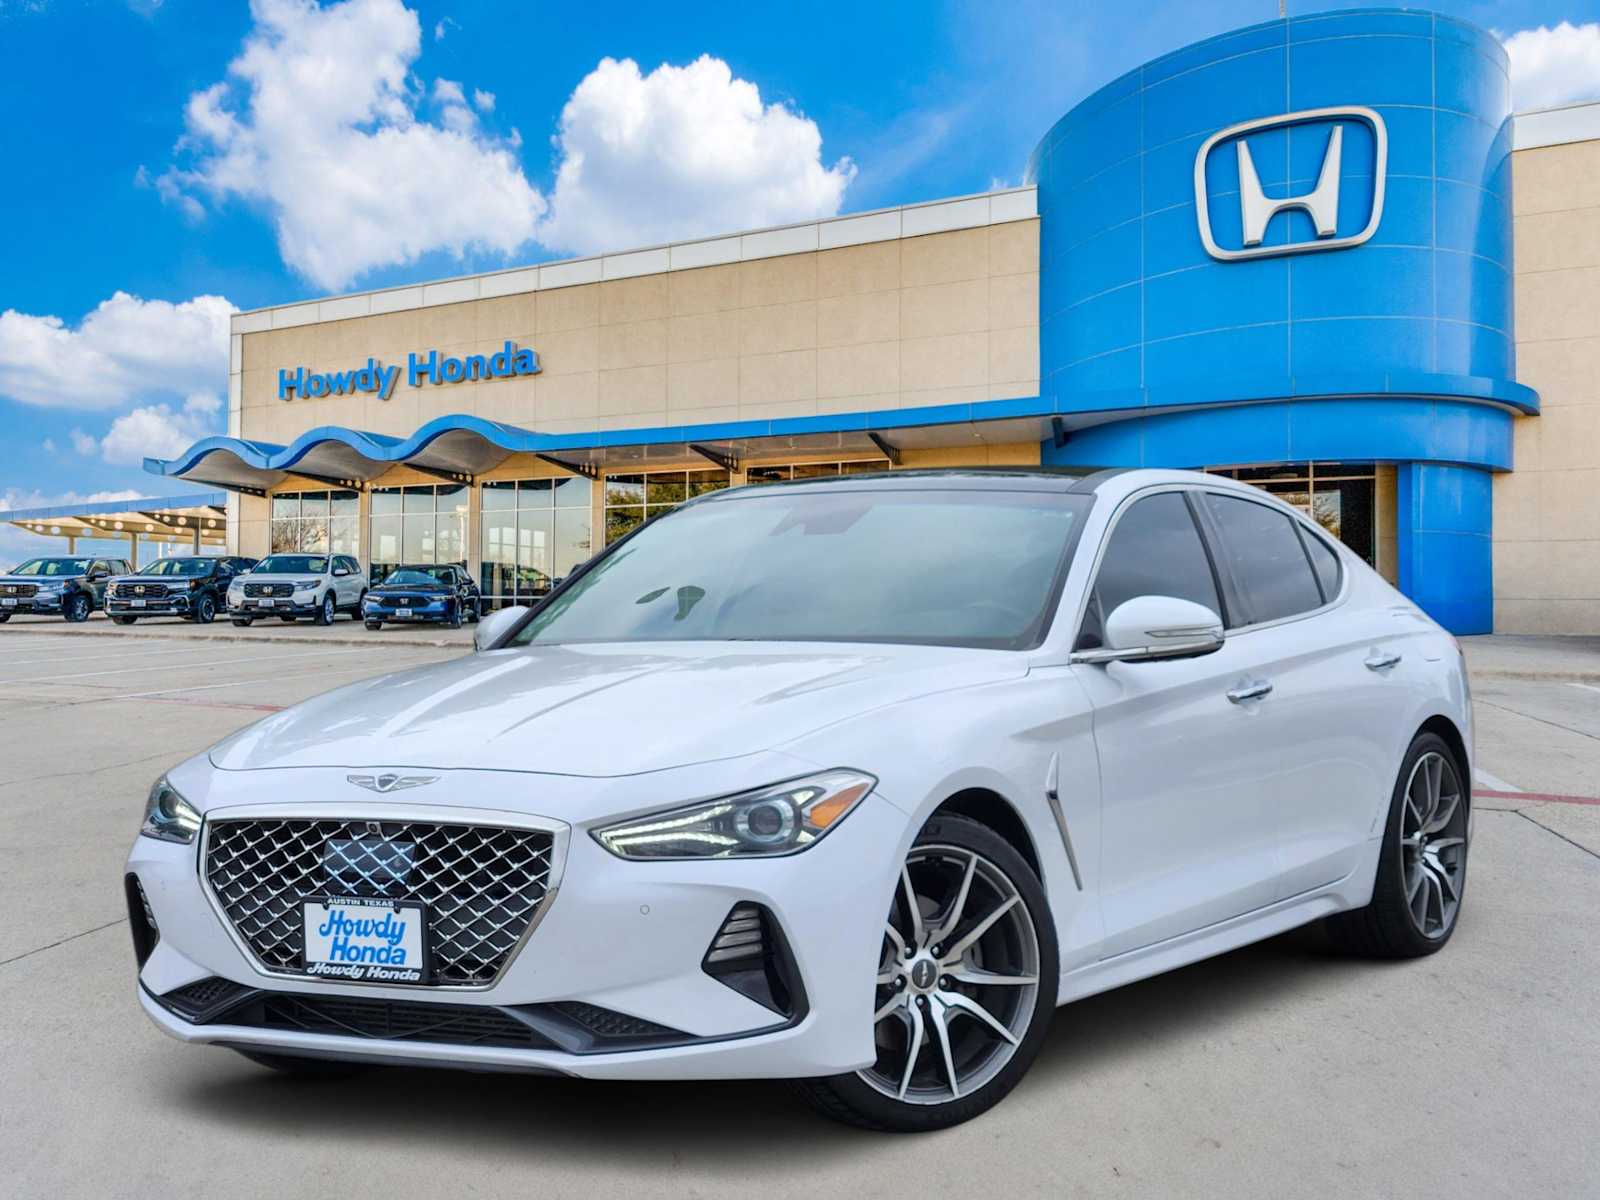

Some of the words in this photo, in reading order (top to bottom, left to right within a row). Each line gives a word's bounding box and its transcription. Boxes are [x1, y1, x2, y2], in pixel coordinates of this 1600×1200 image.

[278, 358, 401, 401] Howdy
[408, 340, 542, 387] Honda
[364, 899, 394, 907] TEXAS
[319, 910, 406, 945] Howdy
[329, 936, 407, 965] Honda
[306, 962, 365, 978] Howdy
[366, 966, 420, 980] Honda
